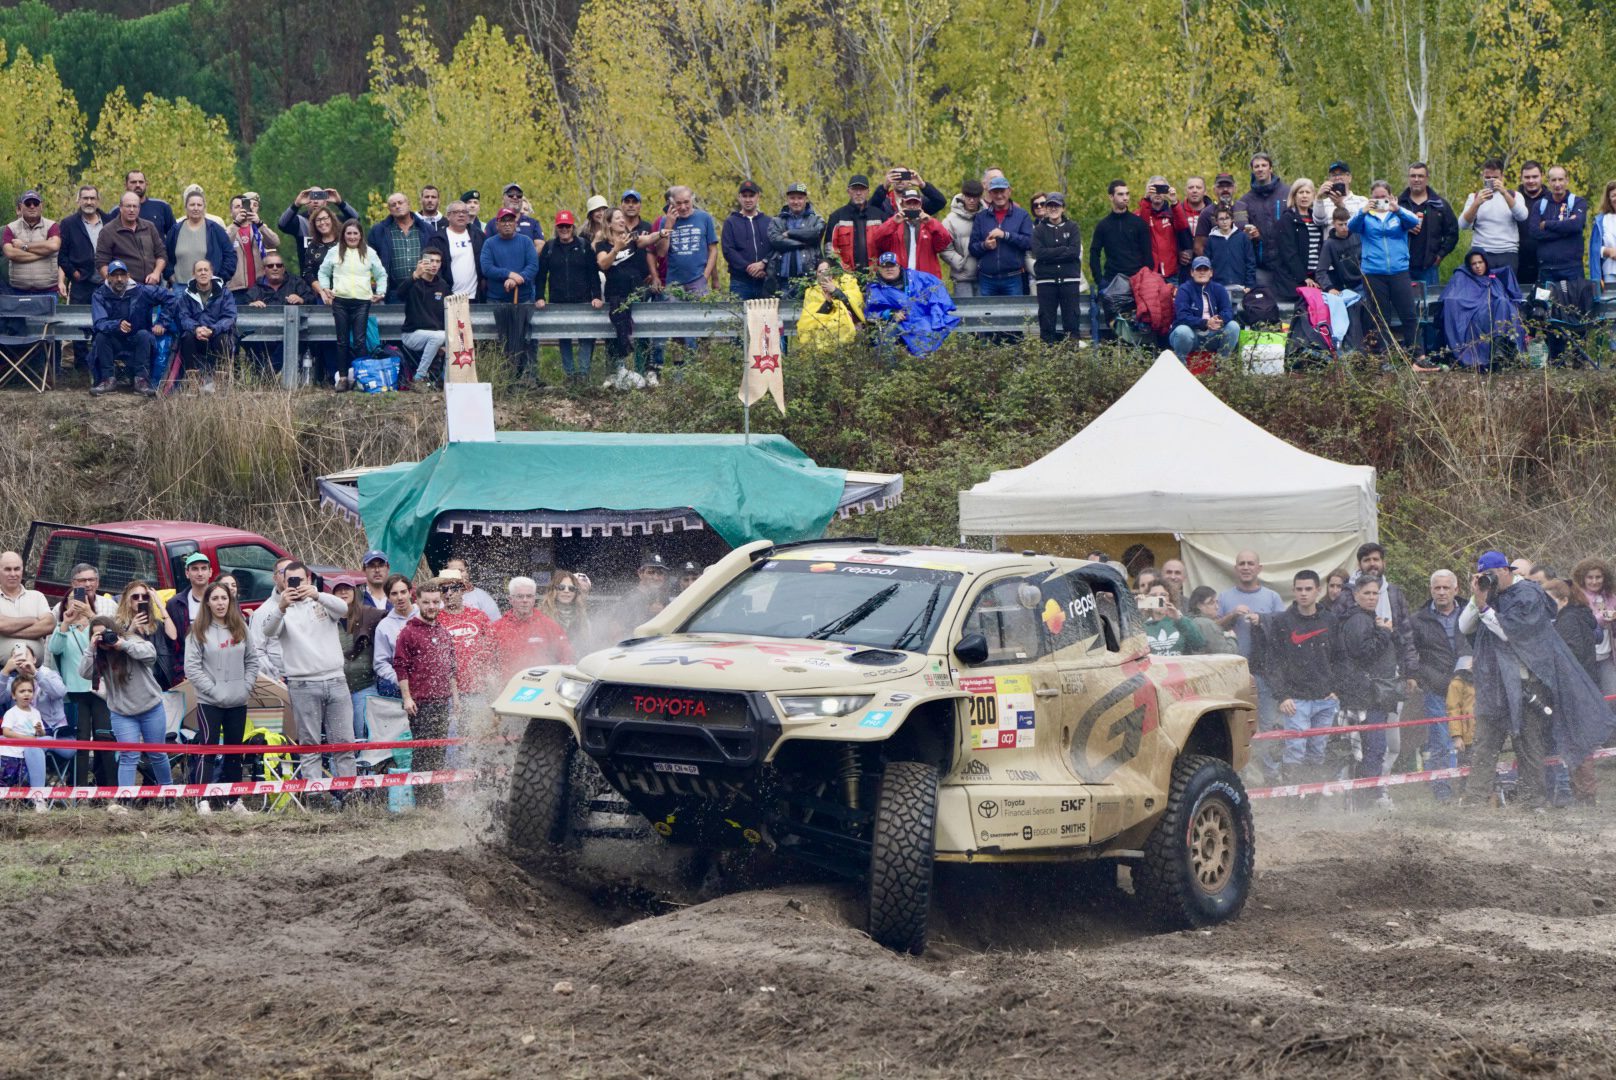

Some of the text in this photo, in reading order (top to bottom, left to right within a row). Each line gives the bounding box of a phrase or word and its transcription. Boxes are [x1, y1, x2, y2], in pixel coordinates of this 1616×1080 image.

[841, 566, 898, 576] repsol
[640, 655, 734, 671] SVR
[633, 695, 707, 717] TOYOTA
[1004, 799, 1025, 808] Toyota
[1060, 798, 1086, 812] SKF
[1005, 807, 1055, 817] Financial Services
[1033, 827, 1058, 837] EDGECAM
[1060, 822, 1086, 834] SMITHS
